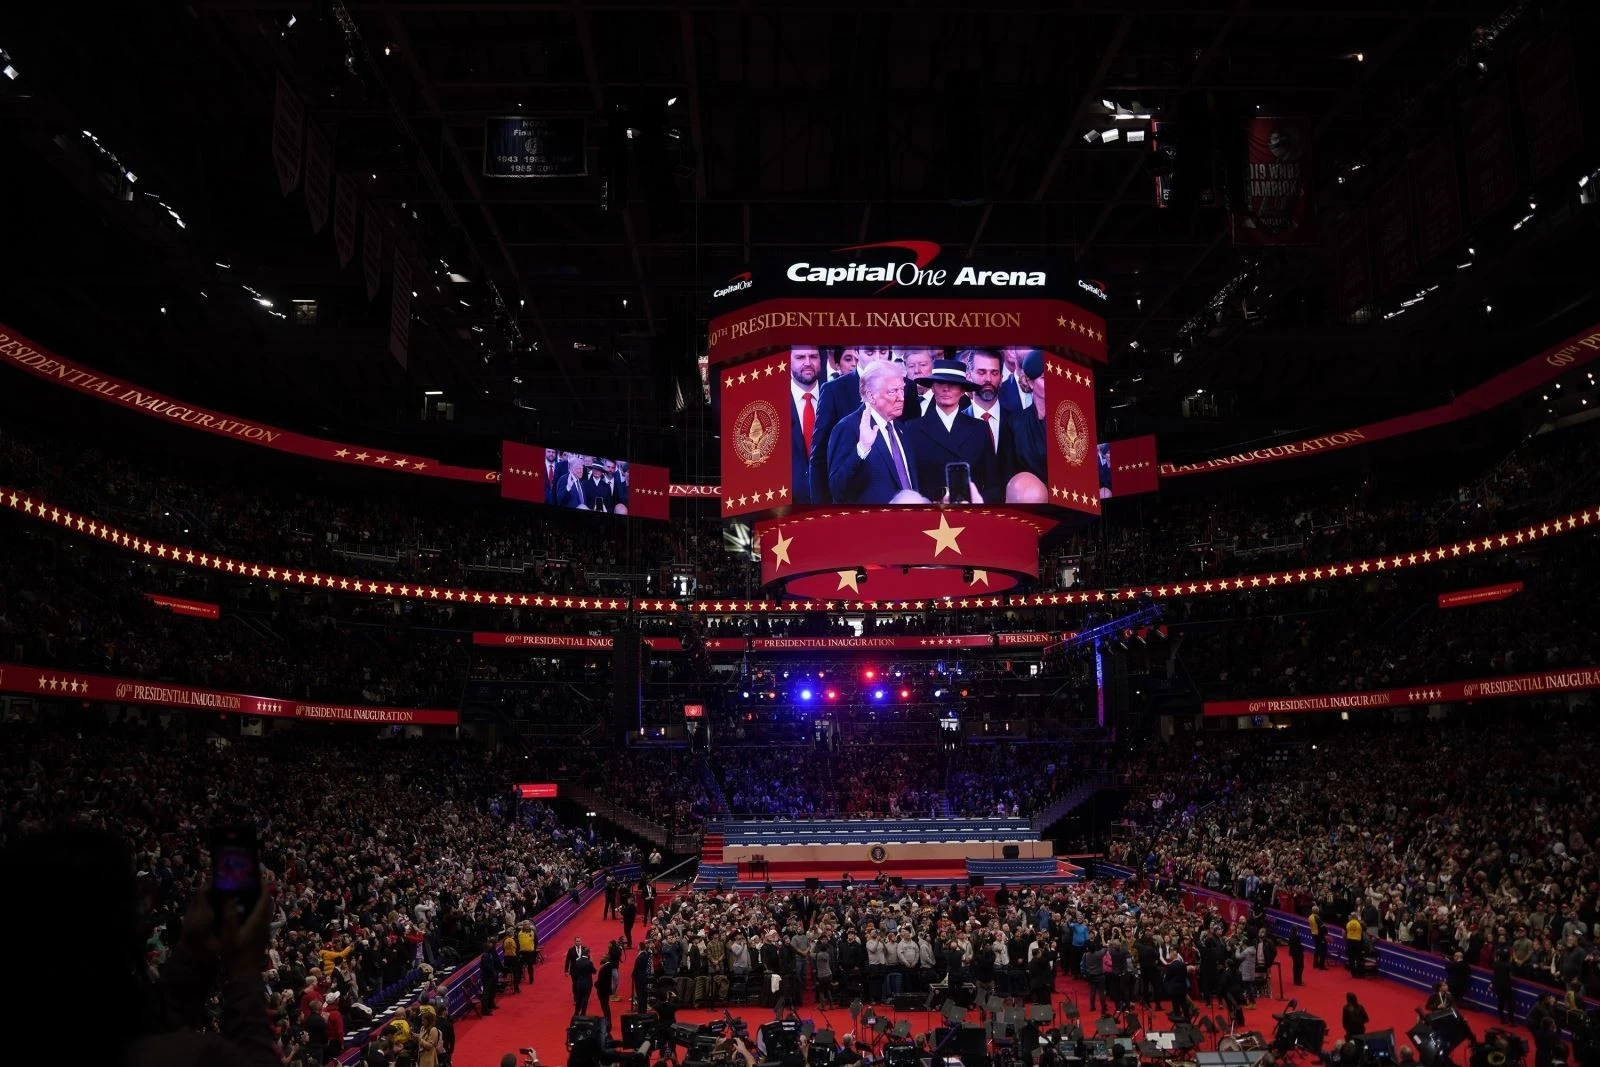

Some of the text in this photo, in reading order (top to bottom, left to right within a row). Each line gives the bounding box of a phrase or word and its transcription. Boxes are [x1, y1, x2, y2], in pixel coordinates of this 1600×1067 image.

[953, 267, 1047, 286] Arena
[730, 311, 861, 340] PRESIDENTIAL
[866, 311, 1021, 328] INAUGURATION
[118, 390, 281, 443] INAUGURATION
[1207, 429, 1366, 468] INAUGURATION
[523, 636, 585, 646] PRESIDENTIAL
[764, 639, 826, 648] PRESIDENTIAL
[828, 638, 895, 647] INAUGURATION
[1480, 677, 1545, 695] PRESIDENTIAL
[1545, 671, 1600, 688] INAUGURA
[134, 684, 190, 705] PRESIDENTIAL
[191, 691, 241, 709] INAUGURATION
[1268, 697, 1329, 711] PRESIDENTIAL
[1330, 693, 1390, 708] INAUGURATION
[353, 709, 413, 721] INAUGURATION
